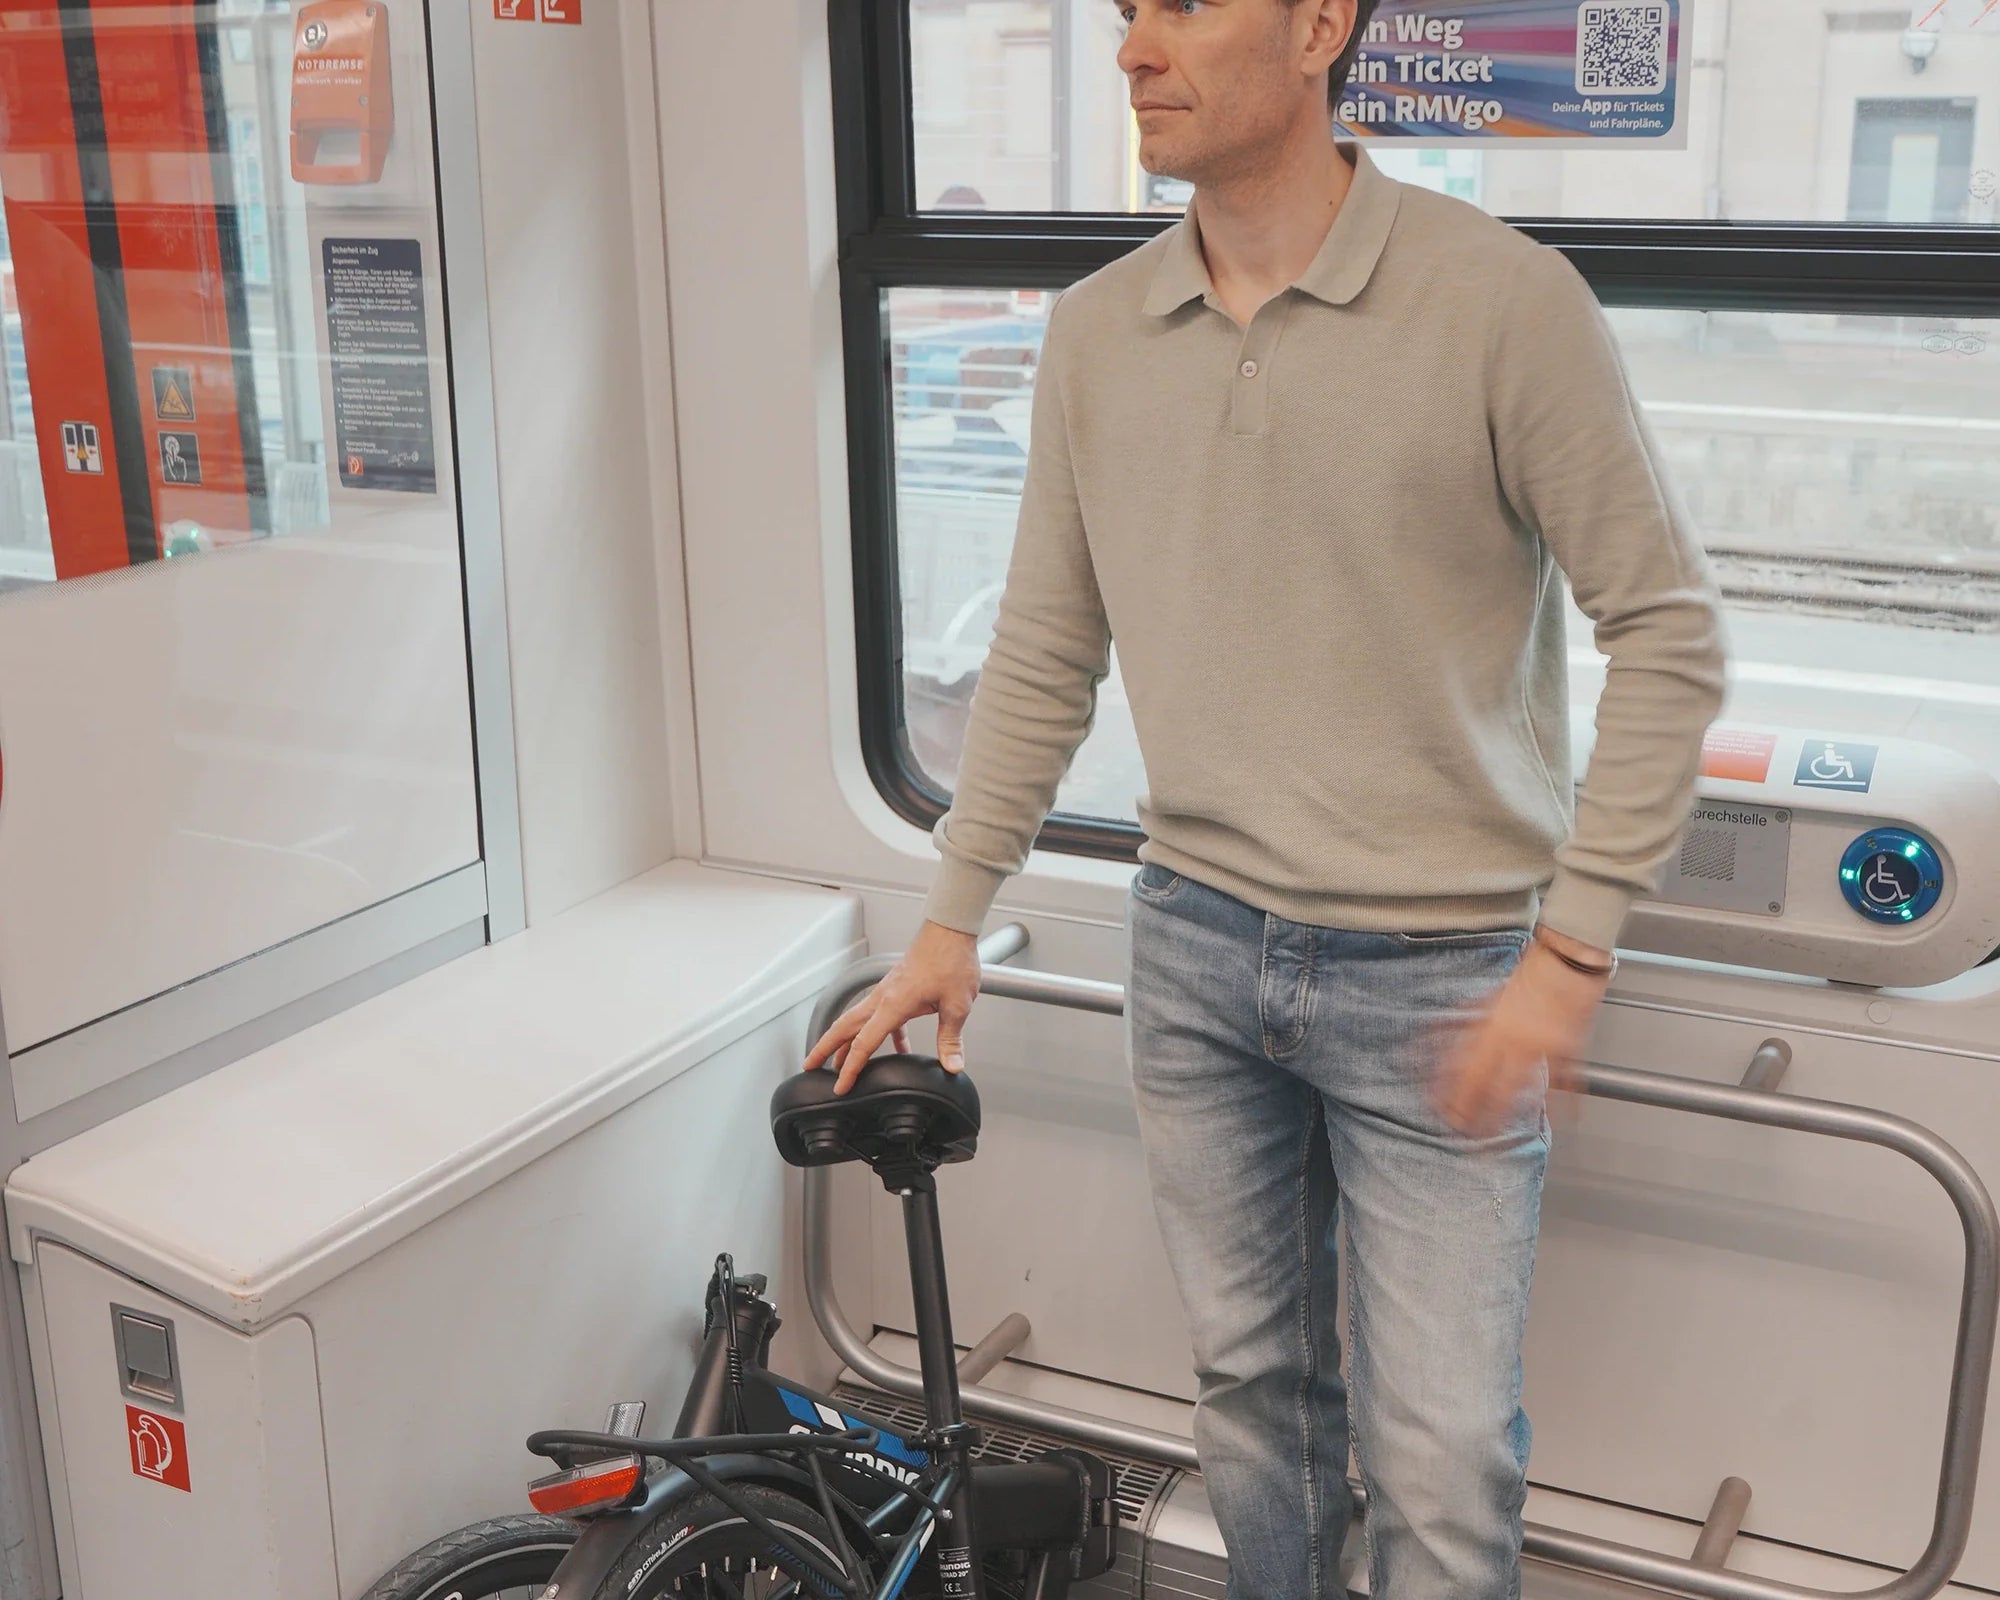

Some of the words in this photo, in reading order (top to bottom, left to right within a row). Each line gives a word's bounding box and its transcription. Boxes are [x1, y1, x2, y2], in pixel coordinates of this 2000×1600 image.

[1395, 14, 1464, 50] Weg
[297, 58, 362, 71] NOTBREMSE
[1394, 52, 1493, 83] Ticket
[1333, 92, 1387, 123] ein
[1394, 95, 1503, 130] RMVgo
[1552, 101, 1581, 113] Deine
[1581, 98, 1612, 115] App
[1613, 101, 1627, 112] für
[1630, 101, 1665, 113] Tickets
[1589, 118, 1609, 129] und
[1611, 118, 1664, 131] Fahrpläne.
[367, 246, 379, 256] Zug
